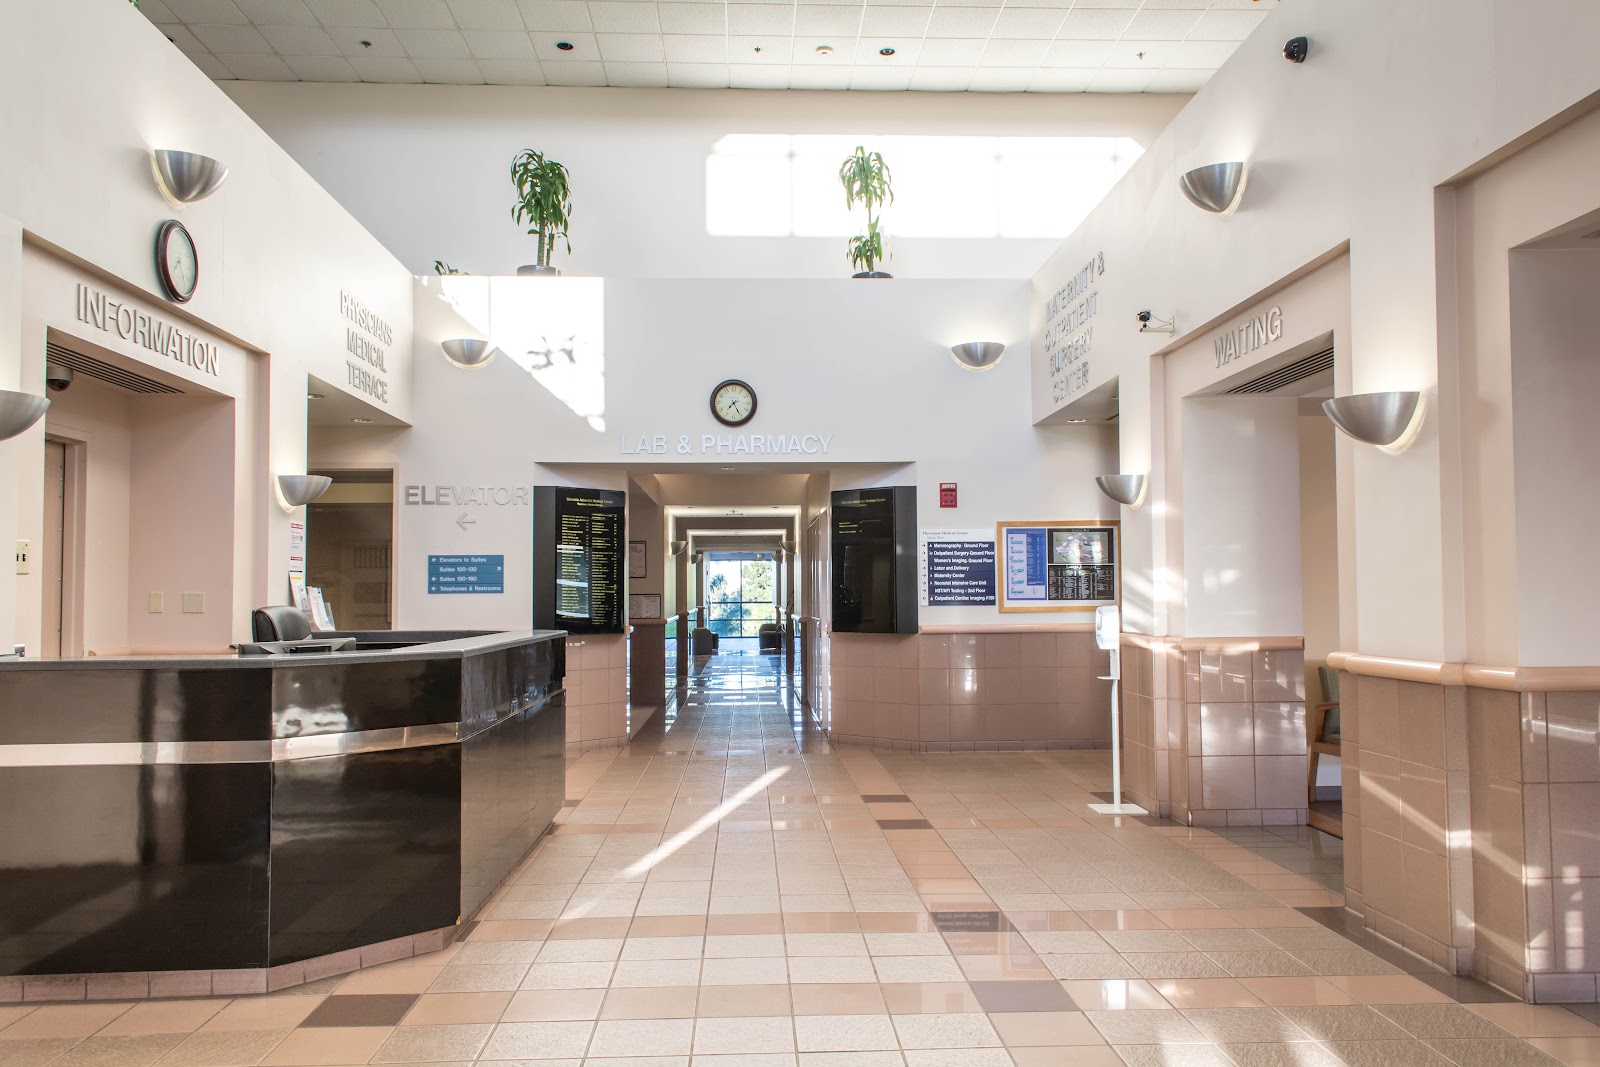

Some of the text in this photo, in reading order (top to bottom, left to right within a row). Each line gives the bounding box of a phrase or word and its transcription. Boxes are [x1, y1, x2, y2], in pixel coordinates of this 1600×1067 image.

[1046, 251, 1106, 322] MATERNITY &
[76, 283, 220, 377] INFORMATION
[340, 289, 393, 347] PHYSICIANS
[1044, 290, 1099, 352] OUTPATIENT
[1214, 306, 1282, 368] WAITING
[346, 327, 388, 374] MEDICAL
[1049, 326, 1093, 378] SURGERY
[346, 360, 389, 404] TERRACE
[1052, 361, 1090, 404] CENTER
[620, 434, 834, 454] LAB & PHARMACY
[404, 486, 528, 506] ELEVATOR
